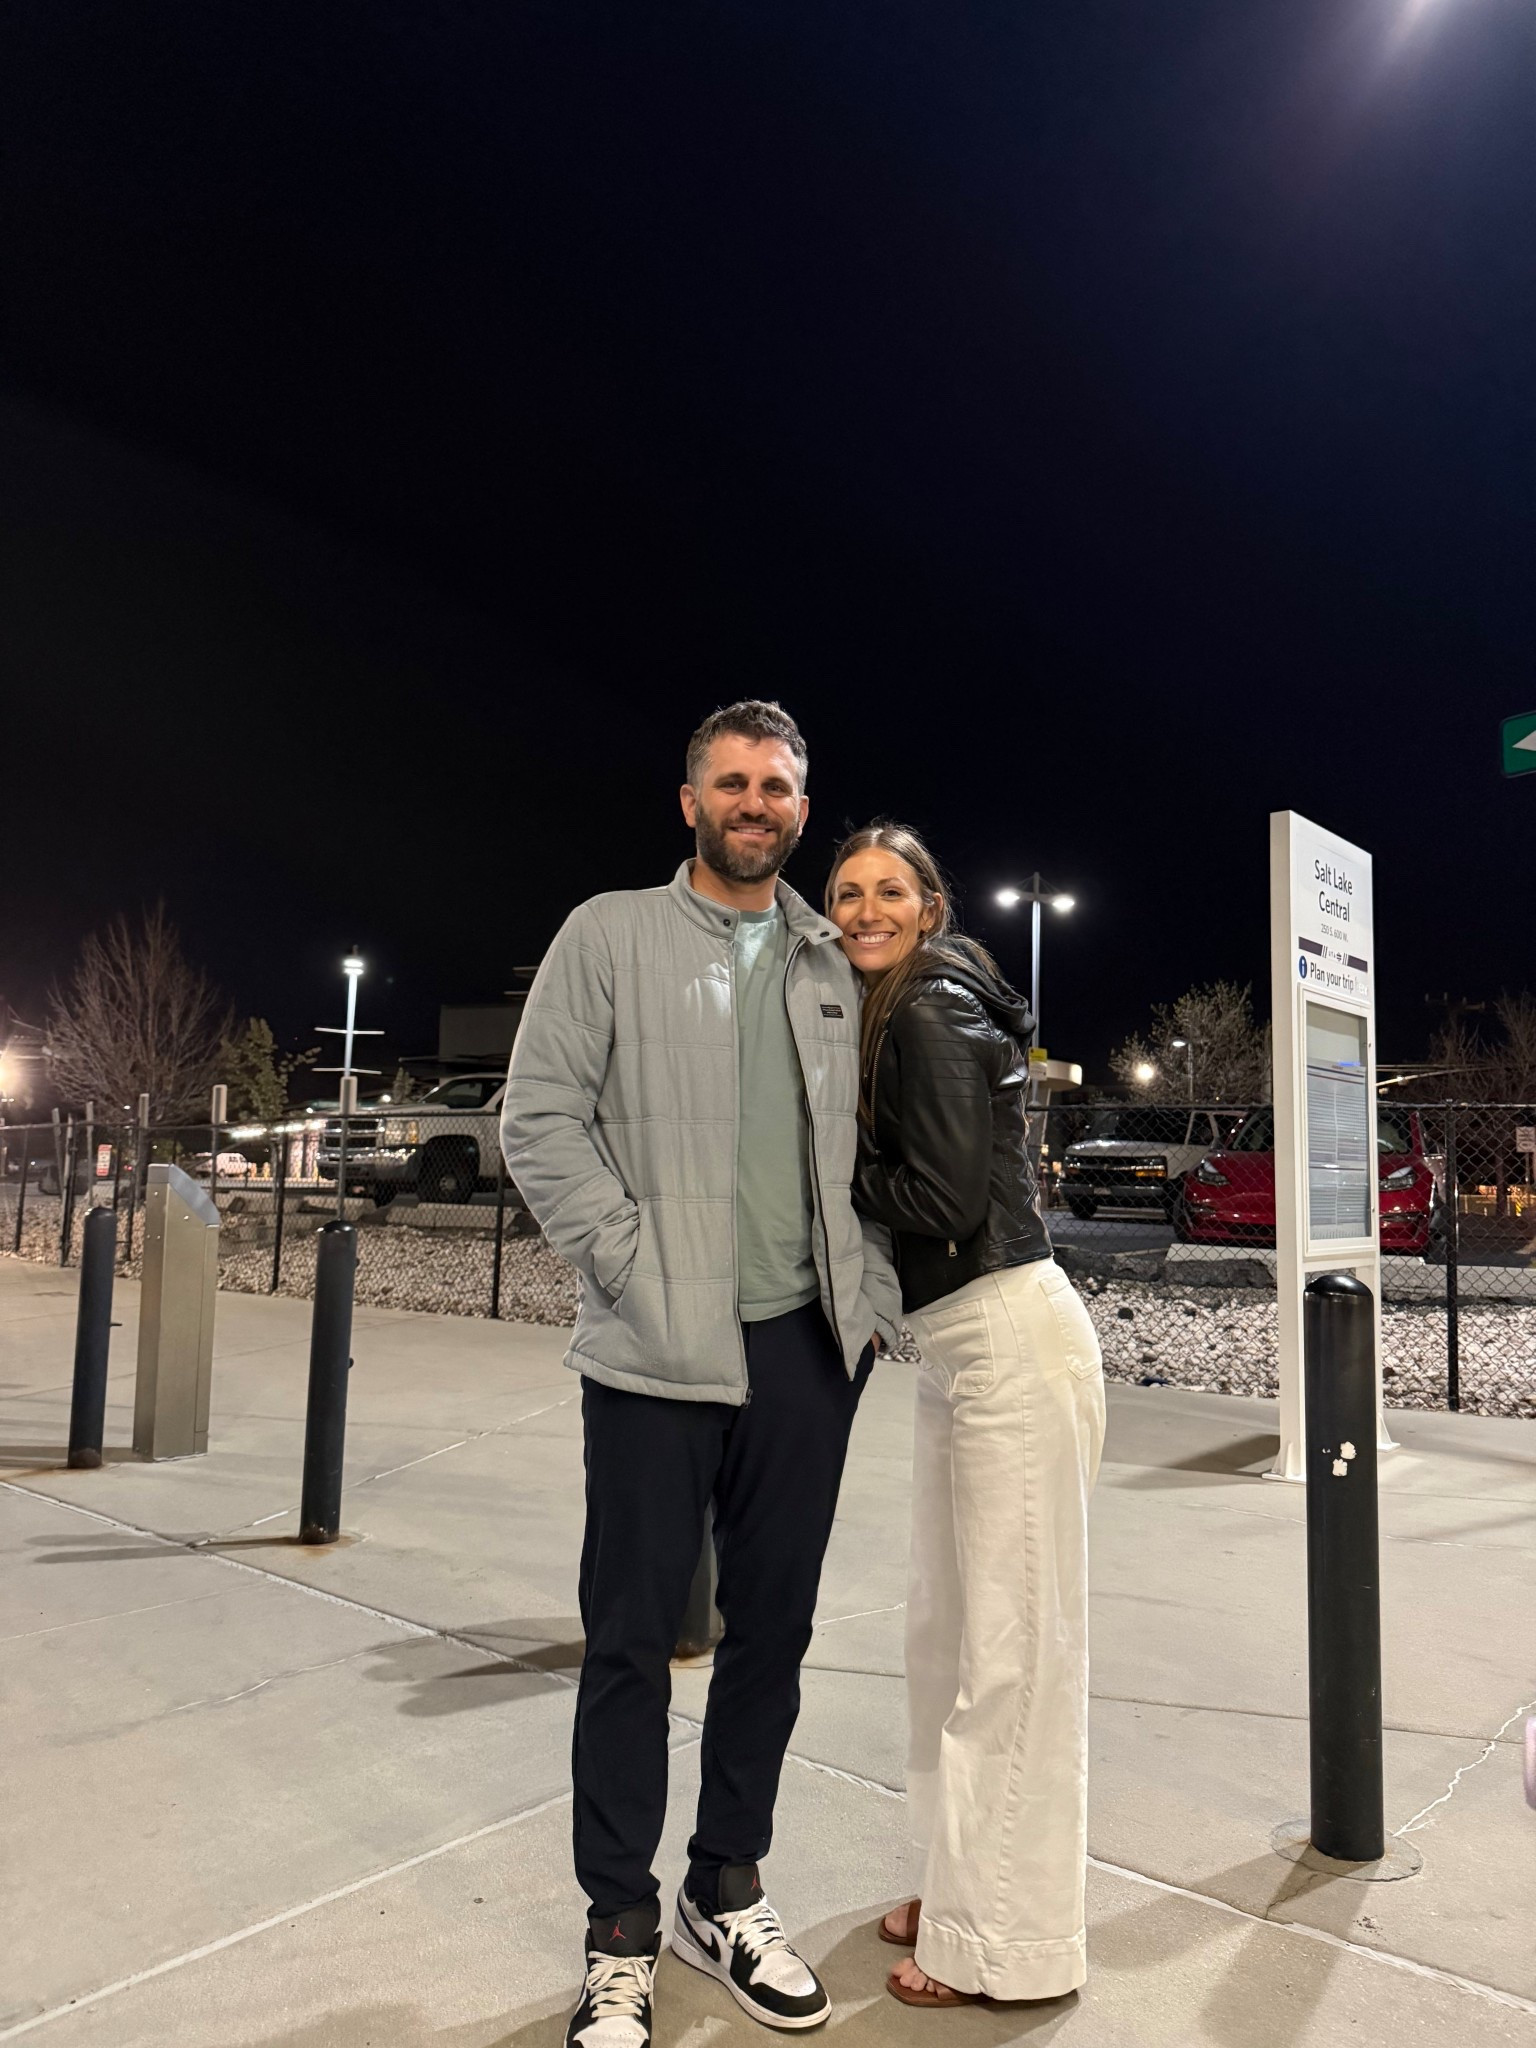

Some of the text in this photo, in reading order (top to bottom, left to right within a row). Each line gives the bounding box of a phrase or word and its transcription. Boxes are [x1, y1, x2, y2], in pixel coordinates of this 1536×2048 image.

[1314, 859, 1353, 896] Salt Lake
[1319, 890, 1350, 923] Central
[1320, 923, 1329, 936] 250
[1333, 929, 1342, 941] 600
[1310, 961, 1326, 982] Plan
[1326, 971, 1341, 987] your
[1342, 973, 1354, 994] trip
